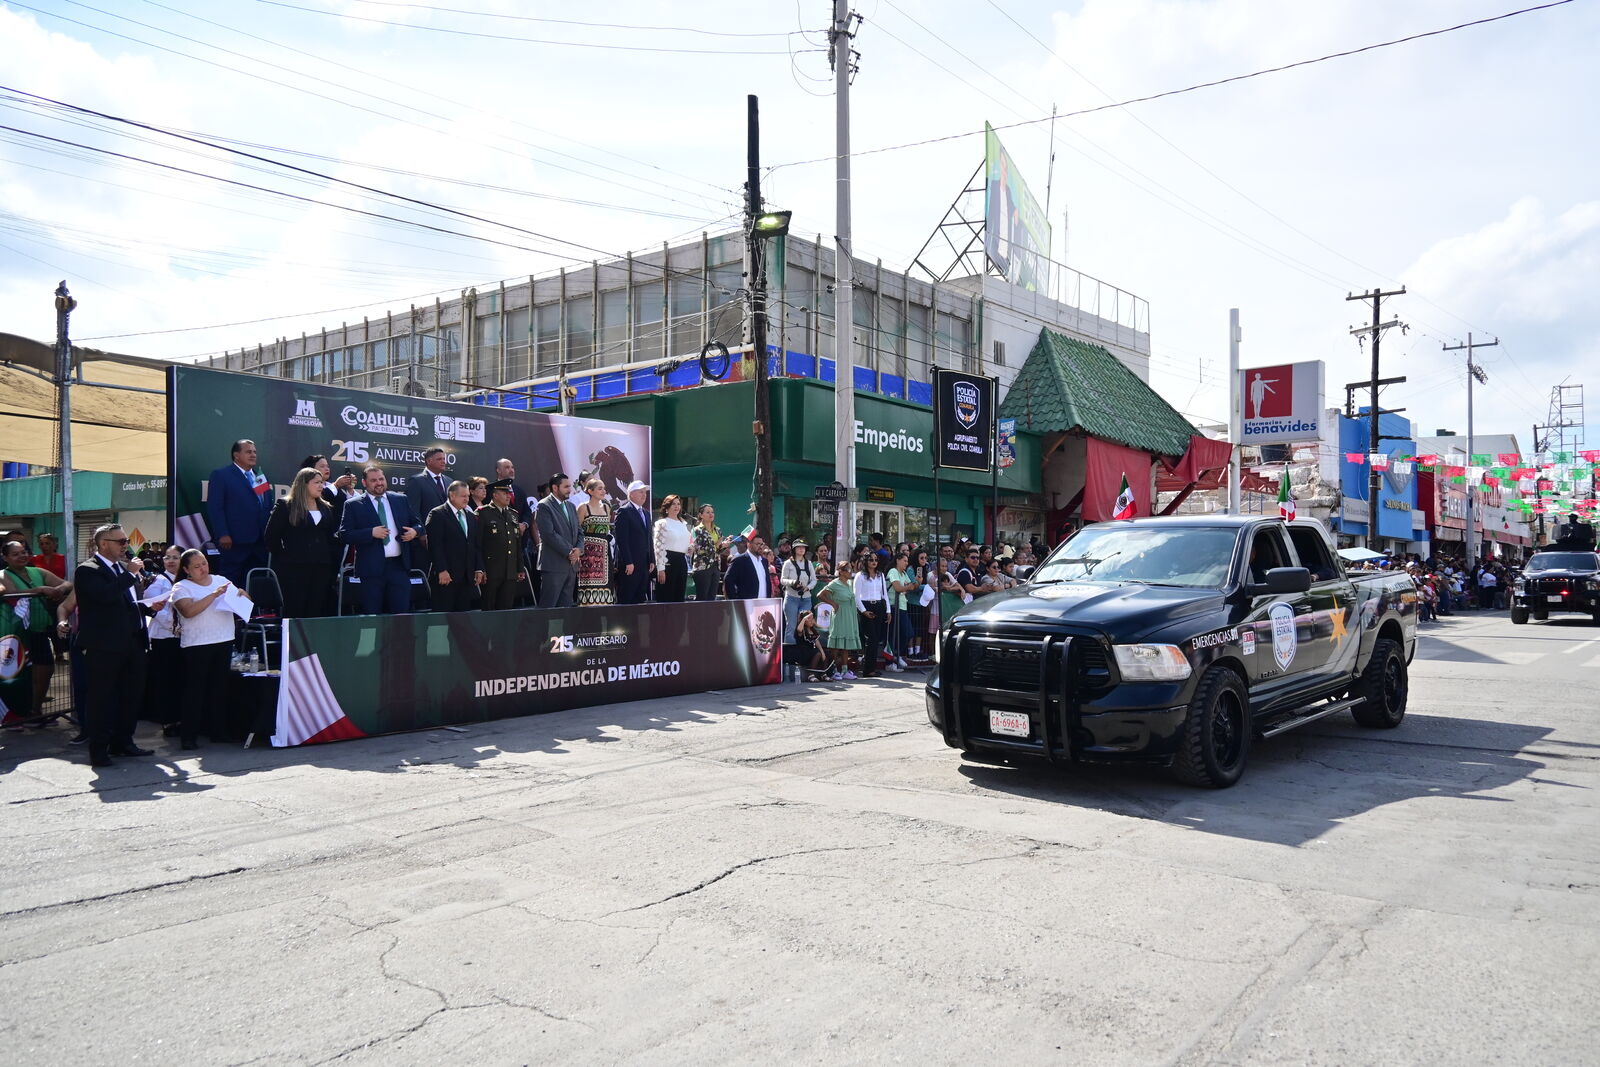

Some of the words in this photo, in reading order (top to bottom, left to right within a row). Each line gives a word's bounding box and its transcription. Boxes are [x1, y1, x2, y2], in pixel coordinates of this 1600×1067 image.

[957, 395, 976, 405] ESTATAL
[341, 405, 419, 428] COAHUILA
[383, 426, 407, 434] DELANTE
[459, 422, 481, 431] SEDU
[1245, 420, 1317, 435] benavides
[854, 420, 923, 453] Empeños
[331, 440, 369, 463] 215
[375, 448, 456, 465] ANIVERSIO
[391, 477, 406, 486] DE
[550, 635, 574, 653] 215
[577, 634, 628, 647] ANIVERSARIO
[1192, 630, 1232, 650] EMERGENCIAS
[475, 669, 605, 697] INDEPENDENCIA
[608, 666, 627, 682] DE
[629, 659, 680, 680] MÉXICO
